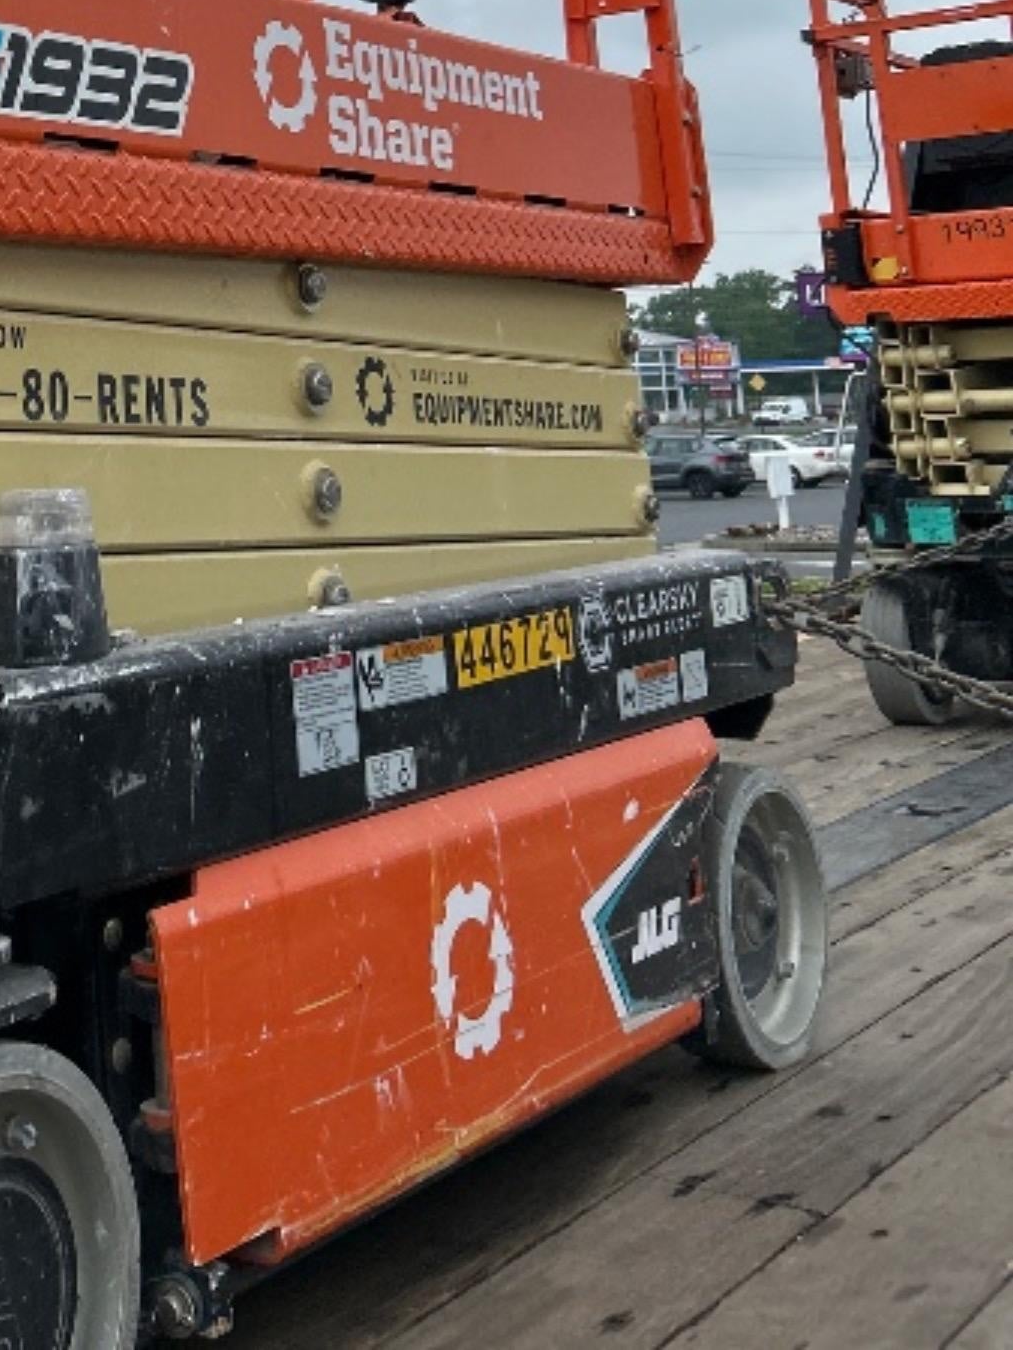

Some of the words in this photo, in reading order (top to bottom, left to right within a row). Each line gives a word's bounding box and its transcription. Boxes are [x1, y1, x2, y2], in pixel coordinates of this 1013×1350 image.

[323, 17, 544, 122] Equipment
[328, 103, 455, 170] Share
[412, 392, 603, 433] EQUIPMENTSHARE.COM
[614, 580, 700, 624] CLEARSKY
[460, 605, 571, 679] 446729
[631, 896, 682, 965] JLG
